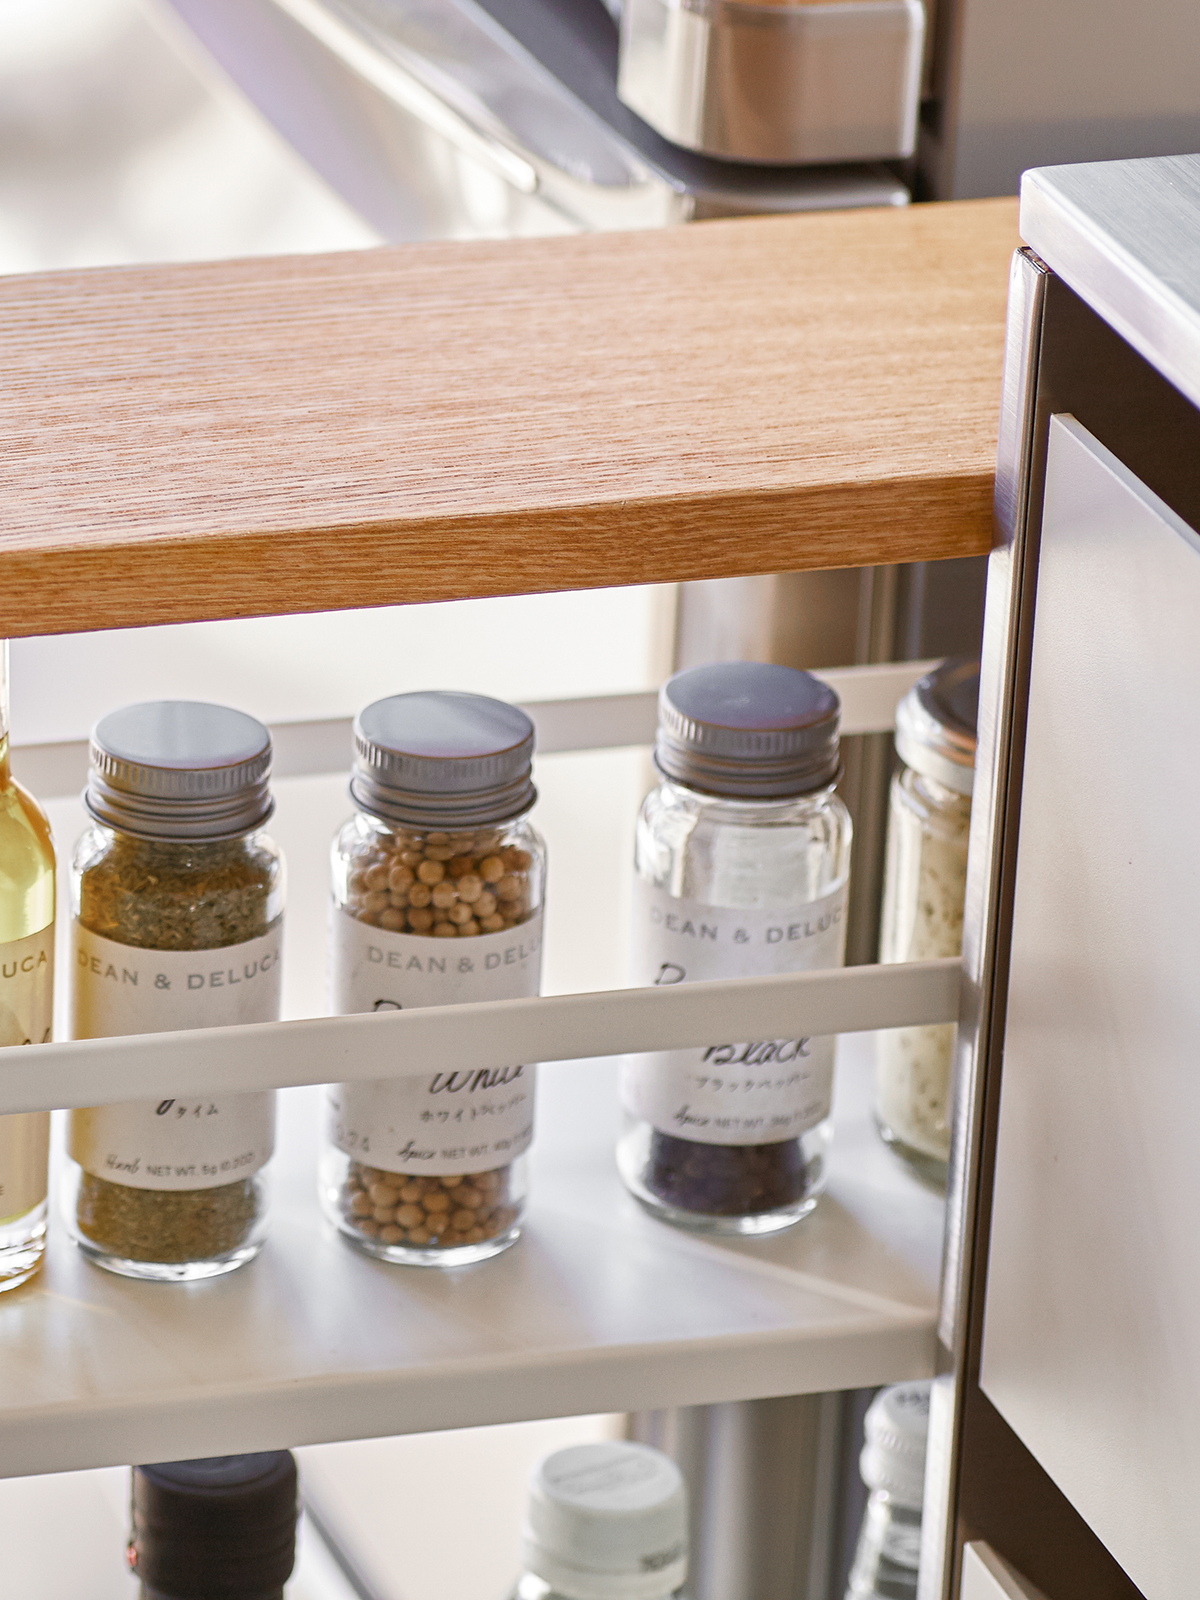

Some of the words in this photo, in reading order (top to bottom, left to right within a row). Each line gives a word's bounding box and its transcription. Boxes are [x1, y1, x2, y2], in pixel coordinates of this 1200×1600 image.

[733, 928, 751, 944] &
[76, 949, 140, 987] DEAN
[153, 973, 171, 991] &
[366, 945, 447, 974] DEAN
[457, 956, 475, 974] &
